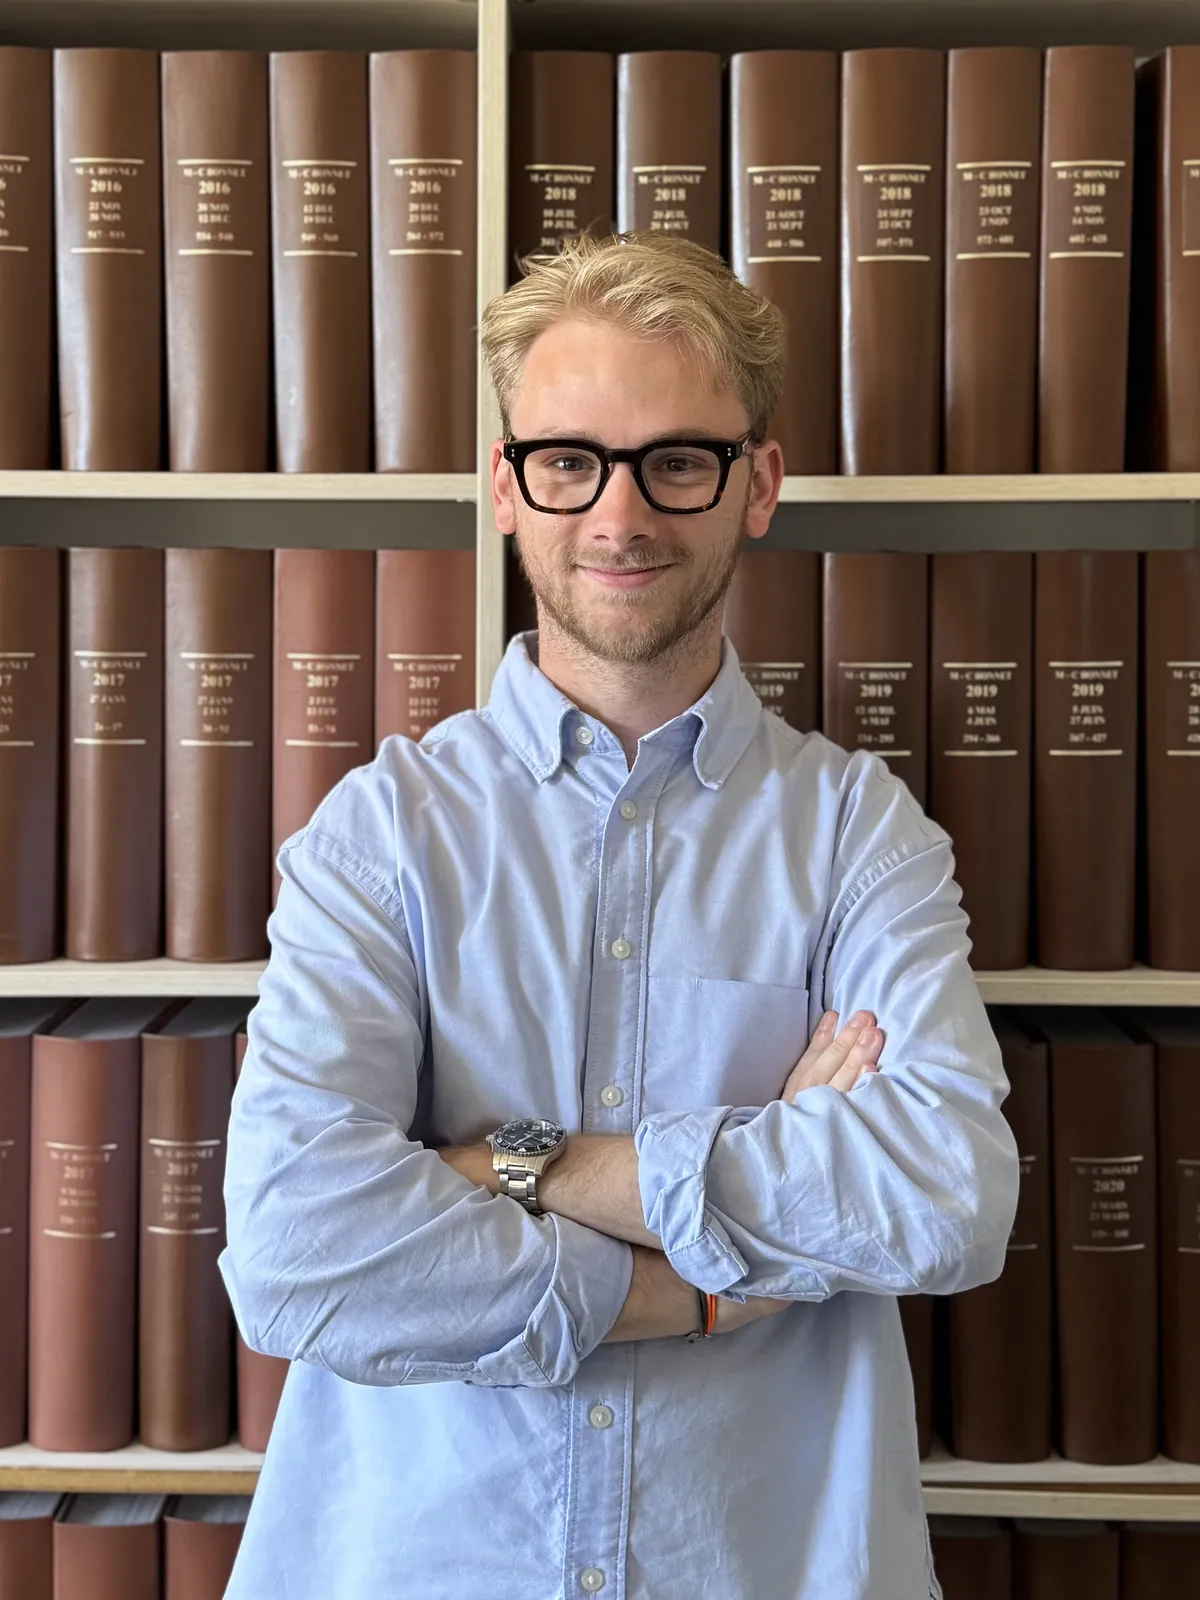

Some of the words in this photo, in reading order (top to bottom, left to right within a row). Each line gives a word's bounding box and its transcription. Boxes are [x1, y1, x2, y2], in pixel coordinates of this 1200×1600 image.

[554, 174, 592, 184] BONNET
[664, 174, 702, 184] BONNET
[778, 174, 816, 184] BONNET
[889, 174, 926, 184] BONNET
[988, 170, 1026, 180] BONNET
[1082, 169, 1120, 180] BONNET
[90, 179, 122, 193] 2016
[198, 180, 231, 195] 2016
[304, 181, 336, 196] 2016
[409, 180, 442, 194] 2016
[980, 184, 1012, 198] 2018
[1073, 183, 1106, 197] 2018
[544, 187, 577, 201] 2018
[654, 188, 687, 202] 2018
[770, 188, 802, 202] 2018
[880, 186, 912, 200] 2018
[889, 208, 914, 219] SEPT
[990, 205, 1013, 216] OCT
[1082, 206, 1104, 215] NOV
[890, 219, 913, 230] OCT
[988, 216, 1012, 226] NOV
[1084, 216, 1106, 226] NOV
[315, 662, 354, 672] BONNET
[418, 662, 456, 672] BONNET
[92, 673, 124, 686] 2017
[762, 672, 798, 681] BONNET
[868, 671, 906, 681] BONNET
[974, 671, 1012, 680] BONNET
[1080, 670, 1118, 680] BONNET
[200, 675, 232, 688] 2017
[307, 675, 338, 688] 2017
[409, 676, 440, 690] 2017
[860, 684, 892, 698] 2019
[966, 684, 998, 698] 2019
[1072, 683, 1104, 696] 2019
[976, 705, 996, 715] MAI
[1080, 704, 1104, 714] JUIN
[869, 716, 890, 726] MAI
[974, 716, 997, 726] JUIN
[1082, 716, 1106, 725] JUIN
[167, 1162, 199, 1176] 2017
[1093, 1180, 1126, 1192] 2020
